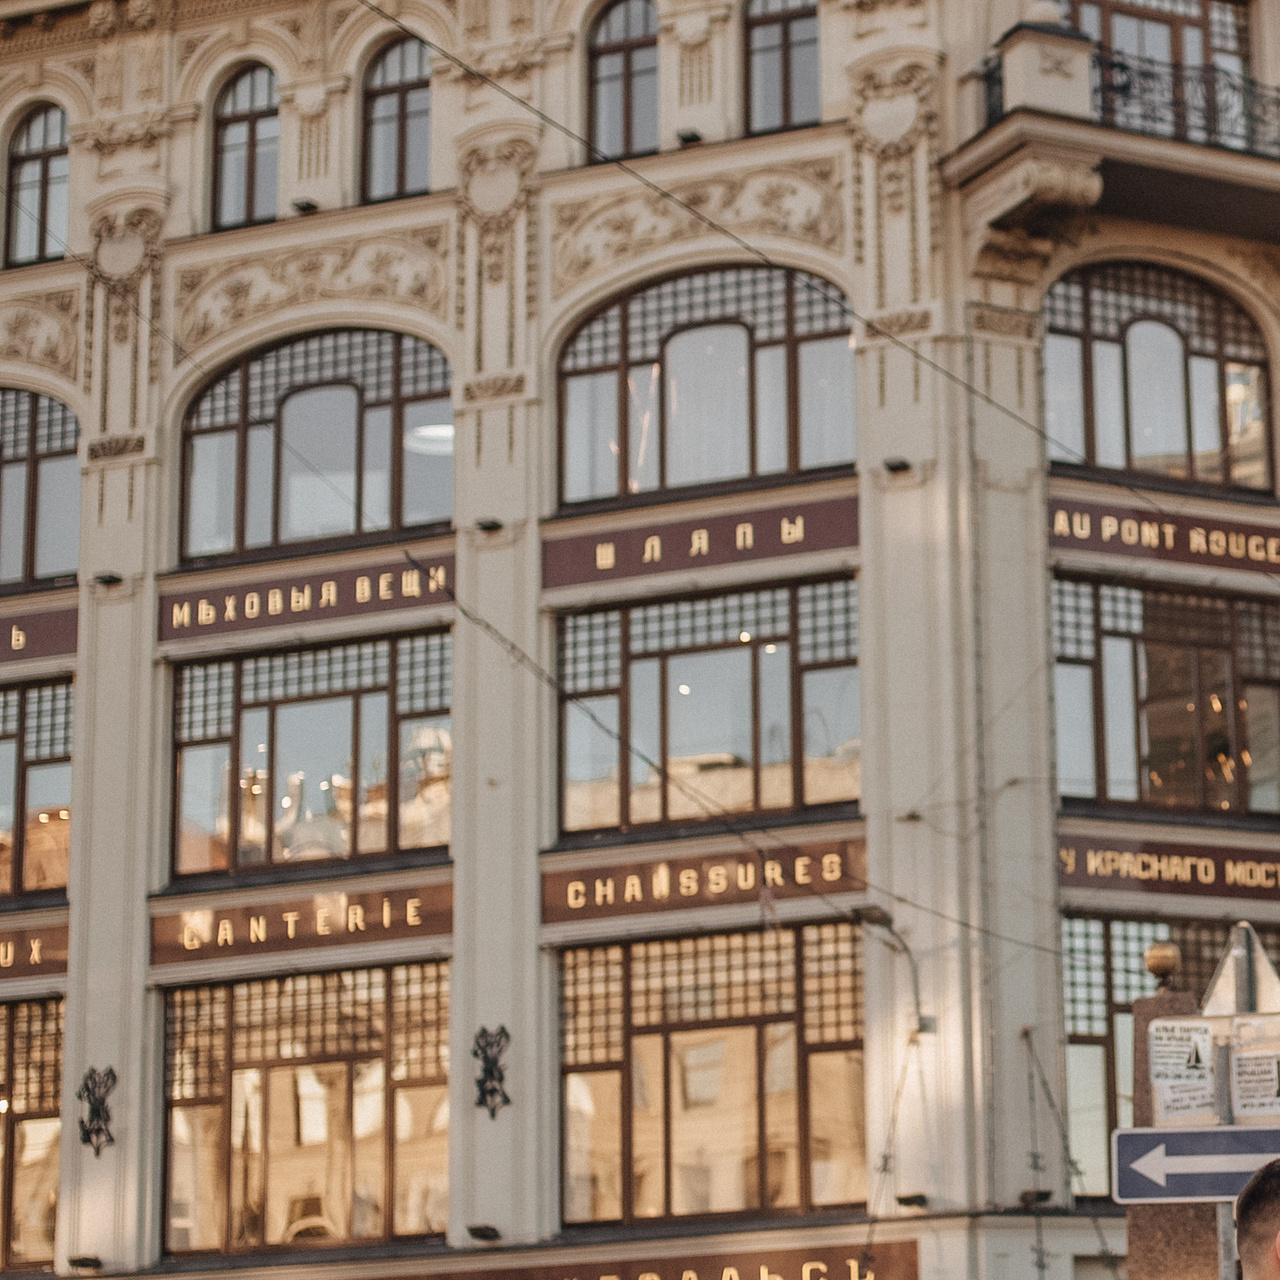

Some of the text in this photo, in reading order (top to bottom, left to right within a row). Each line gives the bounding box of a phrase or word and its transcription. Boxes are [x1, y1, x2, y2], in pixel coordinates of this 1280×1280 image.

[596, 515, 804, 570] ШЛЯПЫ
[1053, 510, 1091, 540] AU
[1101, 516, 1176, 551] PONT
[355, 565, 446, 603] ВЕЩИ
[1059, 848, 1076, 874] У
[1086, 849, 1216, 885] КРАСНАГО
